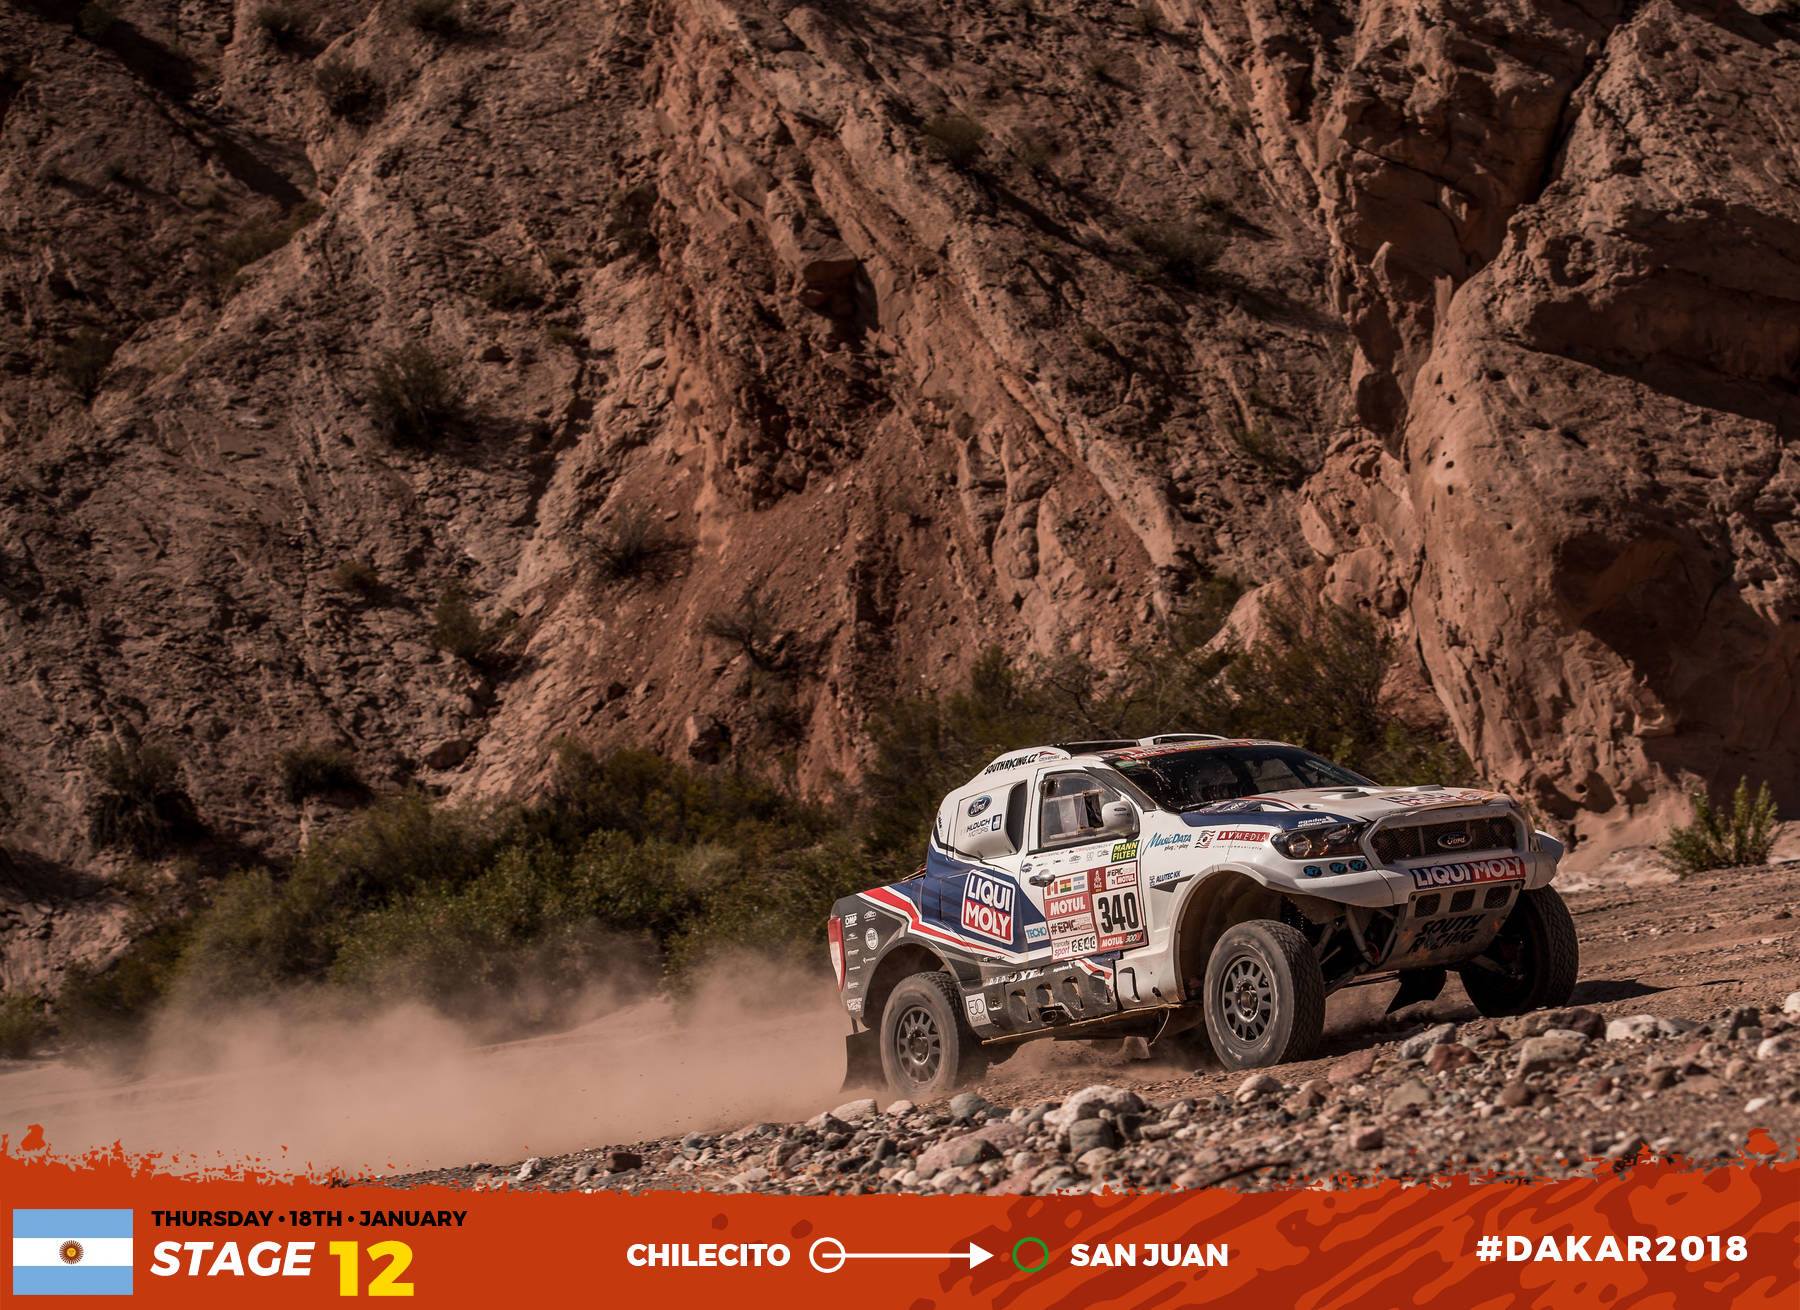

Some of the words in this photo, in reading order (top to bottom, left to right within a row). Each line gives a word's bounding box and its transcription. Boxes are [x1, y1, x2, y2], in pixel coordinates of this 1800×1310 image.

[1112, 850, 1136, 861] FILTER
[1114, 842, 1137, 853] MANN
[1413, 863, 1472, 887] LIQUI
[1472, 856, 1522, 880] MOLY
[967, 875, 1012, 912] LIQUI
[1050, 896, 1086, 916] MOTUL
[1098, 892, 1139, 934] 340
[844, 915, 858, 925] OMP
[965, 901, 1011, 937] MOLY
[1419, 913, 1487, 936] SOUTH
[1102, 936, 1124, 947] MOTUL
